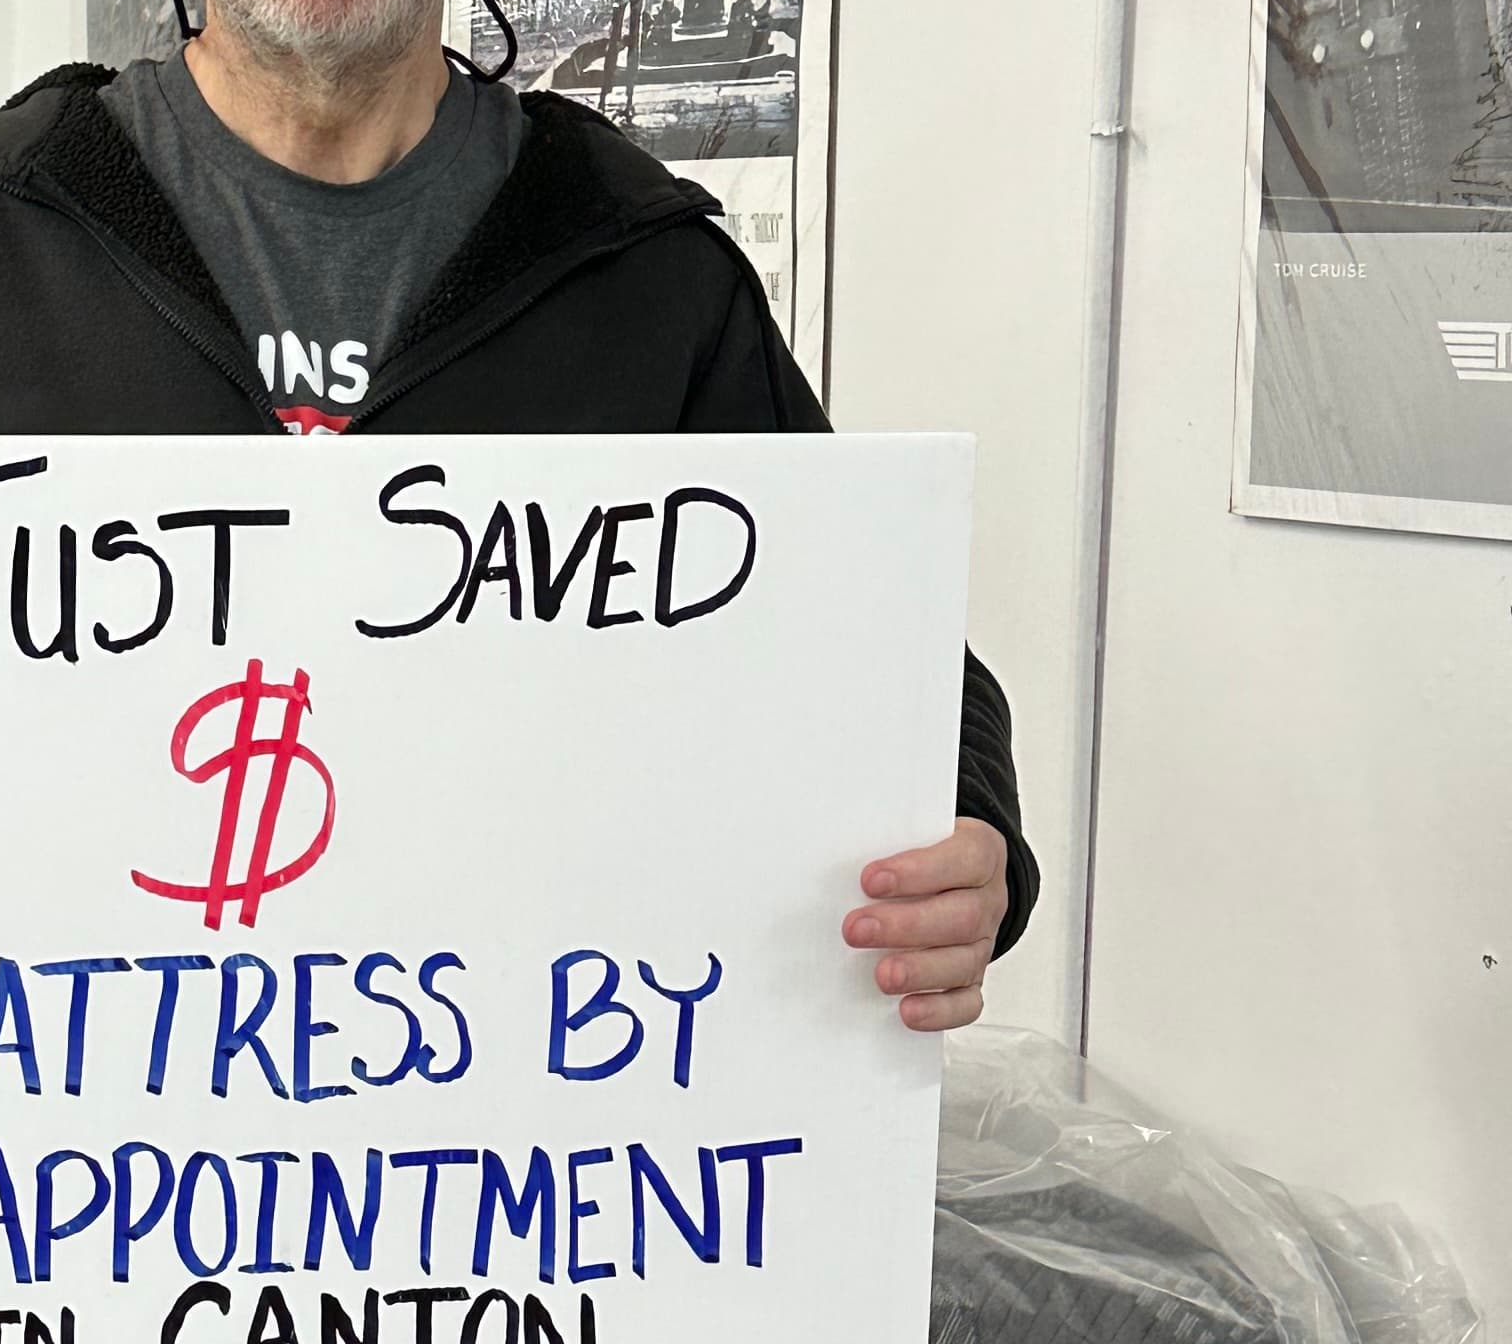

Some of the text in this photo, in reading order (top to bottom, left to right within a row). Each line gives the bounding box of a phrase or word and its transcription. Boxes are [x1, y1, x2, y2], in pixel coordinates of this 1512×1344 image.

[1273, 262, 1367, 278] TOM CRUISE
[355, 465, 757, 639] SAVED
[131, 659, 336, 932] $
[548, 950, 723, 1089] BY
